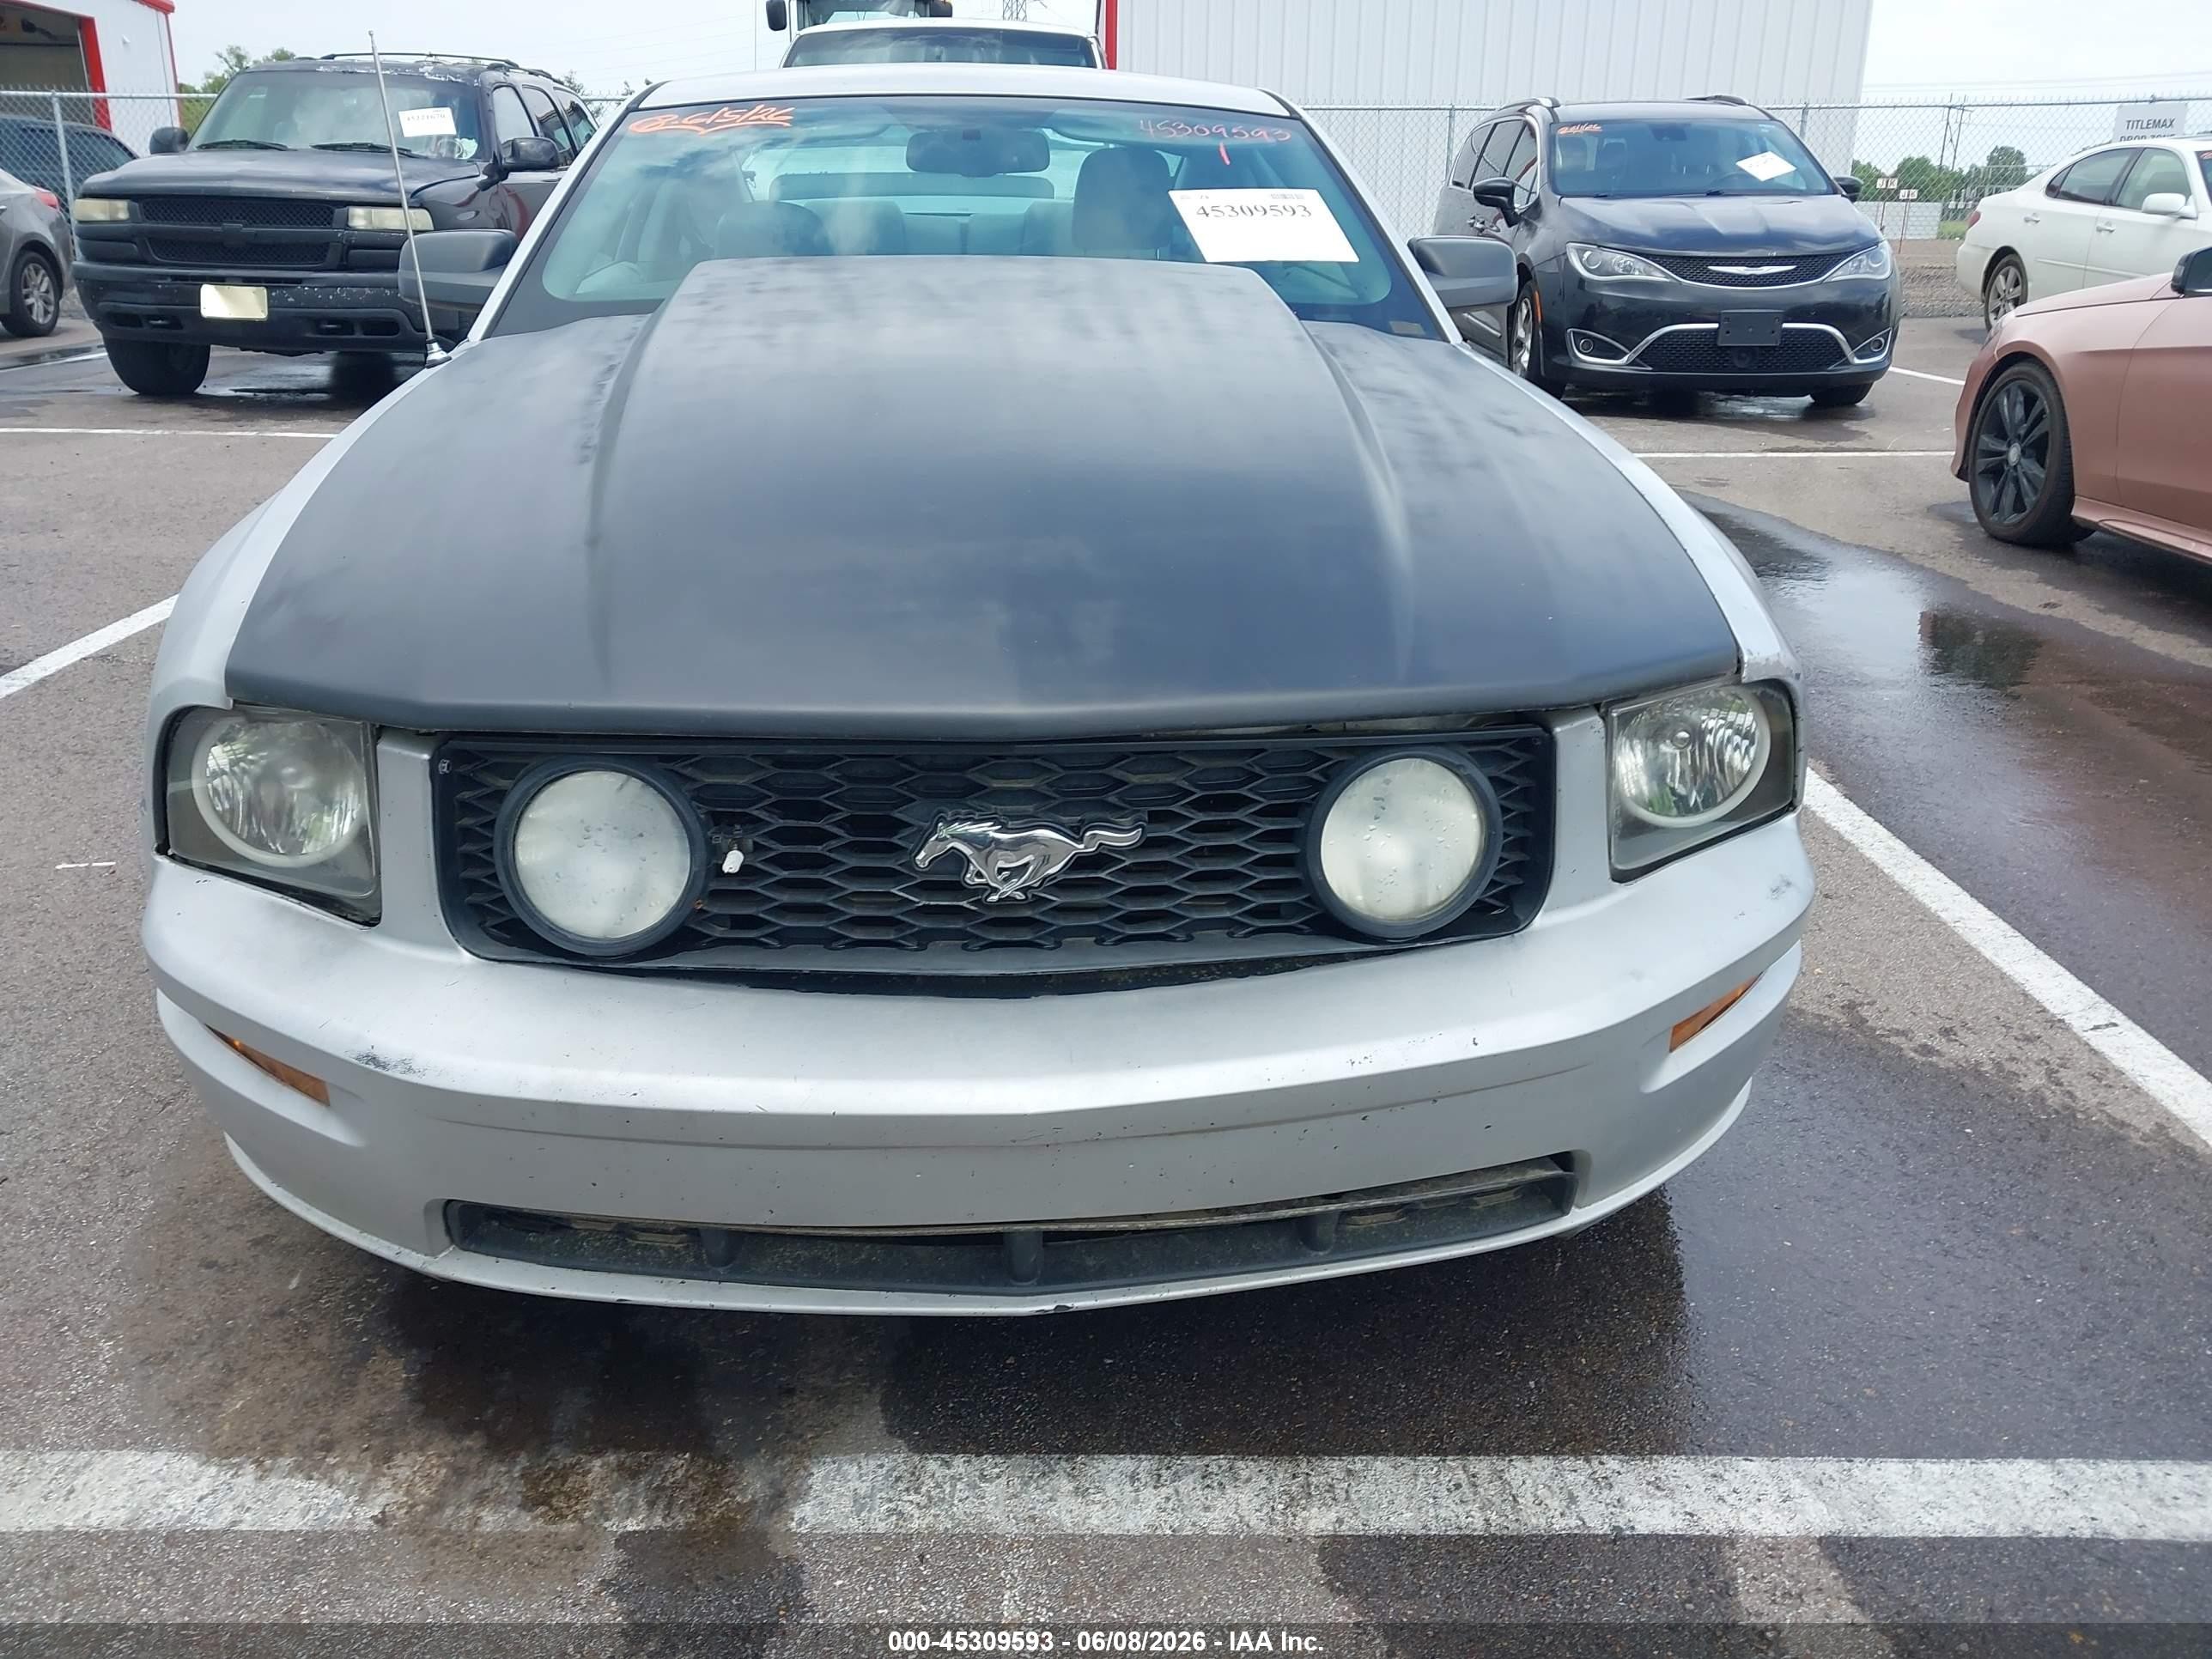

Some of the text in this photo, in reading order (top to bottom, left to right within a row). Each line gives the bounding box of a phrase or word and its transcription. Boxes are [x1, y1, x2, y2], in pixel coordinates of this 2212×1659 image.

[1139, 119, 1291, 141] 45309593
[2125, 118, 2176, 130] TITLEMAX
[1195, 204, 1313, 218] 45309593
